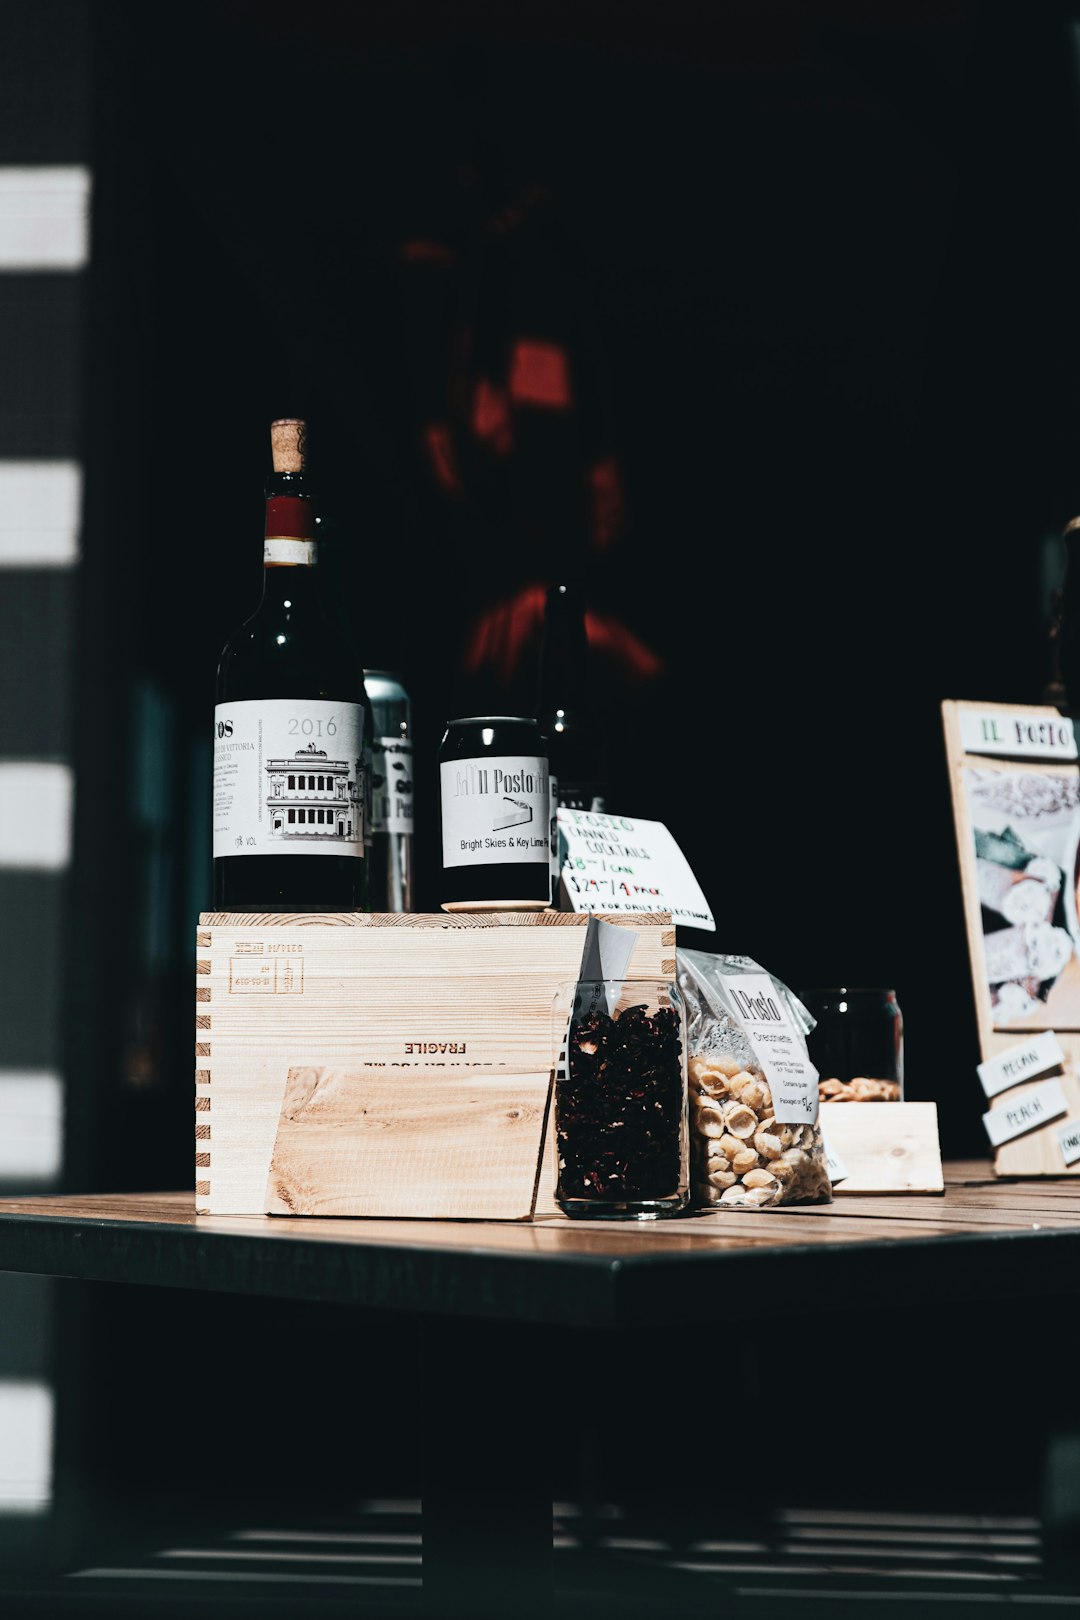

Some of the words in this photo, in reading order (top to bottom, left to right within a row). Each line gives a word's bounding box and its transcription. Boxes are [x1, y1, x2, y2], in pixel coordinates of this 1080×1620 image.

[288, 716, 337, 736] 2016
[227, 743, 255, 751] VITTORIA
[493, 769, 533, 794] Posto
[246, 836, 257, 846] VOL
[569, 826, 620, 843] CANNED
[460, 838, 483, 851] Bright
[485, 838, 507, 849] Skies
[509, 837, 515, 847] &
[516, 837, 530, 849] Key
[530, 838, 544, 847] Lime
[586, 840, 651, 860] COCKTAILS
[579, 904, 596, 912] ASK
[602, 903, 621, 911] FOR
[626, 903, 653, 913] DAILY
[738, 990, 782, 1021] Posto
[405, 1043, 466, 1054] FRAGILE
[1002, 1050, 1040, 1077] PECAN
[1006, 1097, 1043, 1127] PEACH
